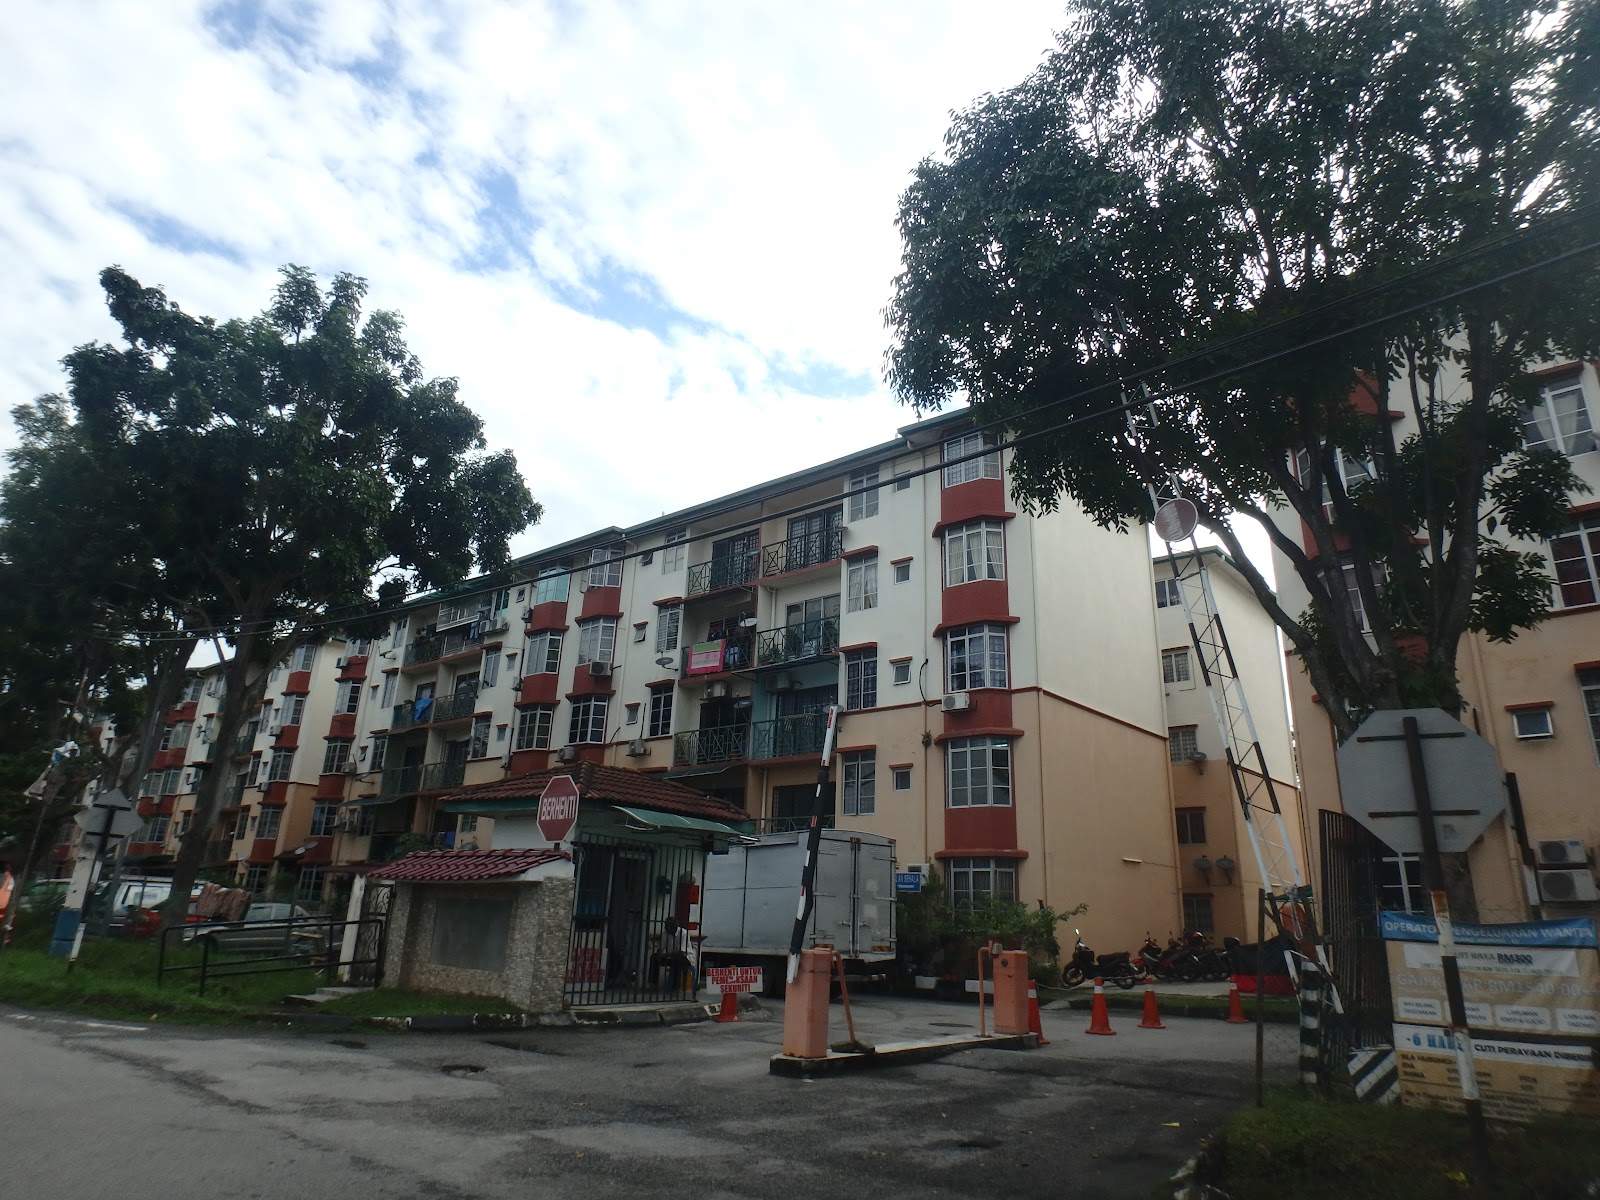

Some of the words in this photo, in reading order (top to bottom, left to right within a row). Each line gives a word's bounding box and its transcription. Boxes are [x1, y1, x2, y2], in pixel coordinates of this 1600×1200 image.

[541, 796, 576, 820] BERHENTI
[1384, 921, 1438, 934] OPERATO
[1540, 926, 1594, 938] WANITA
[706, 968, 739, 976] BERHENTI
[739, 967, 762, 975] UNTUK
[711, 976, 758, 984] PEMEKSAAN
[720, 984, 751, 993] SEKURITI
[1474, 1043, 1495, 1053] CUTI
[1497, 1045, 1552, 1059] PERAYAAN
